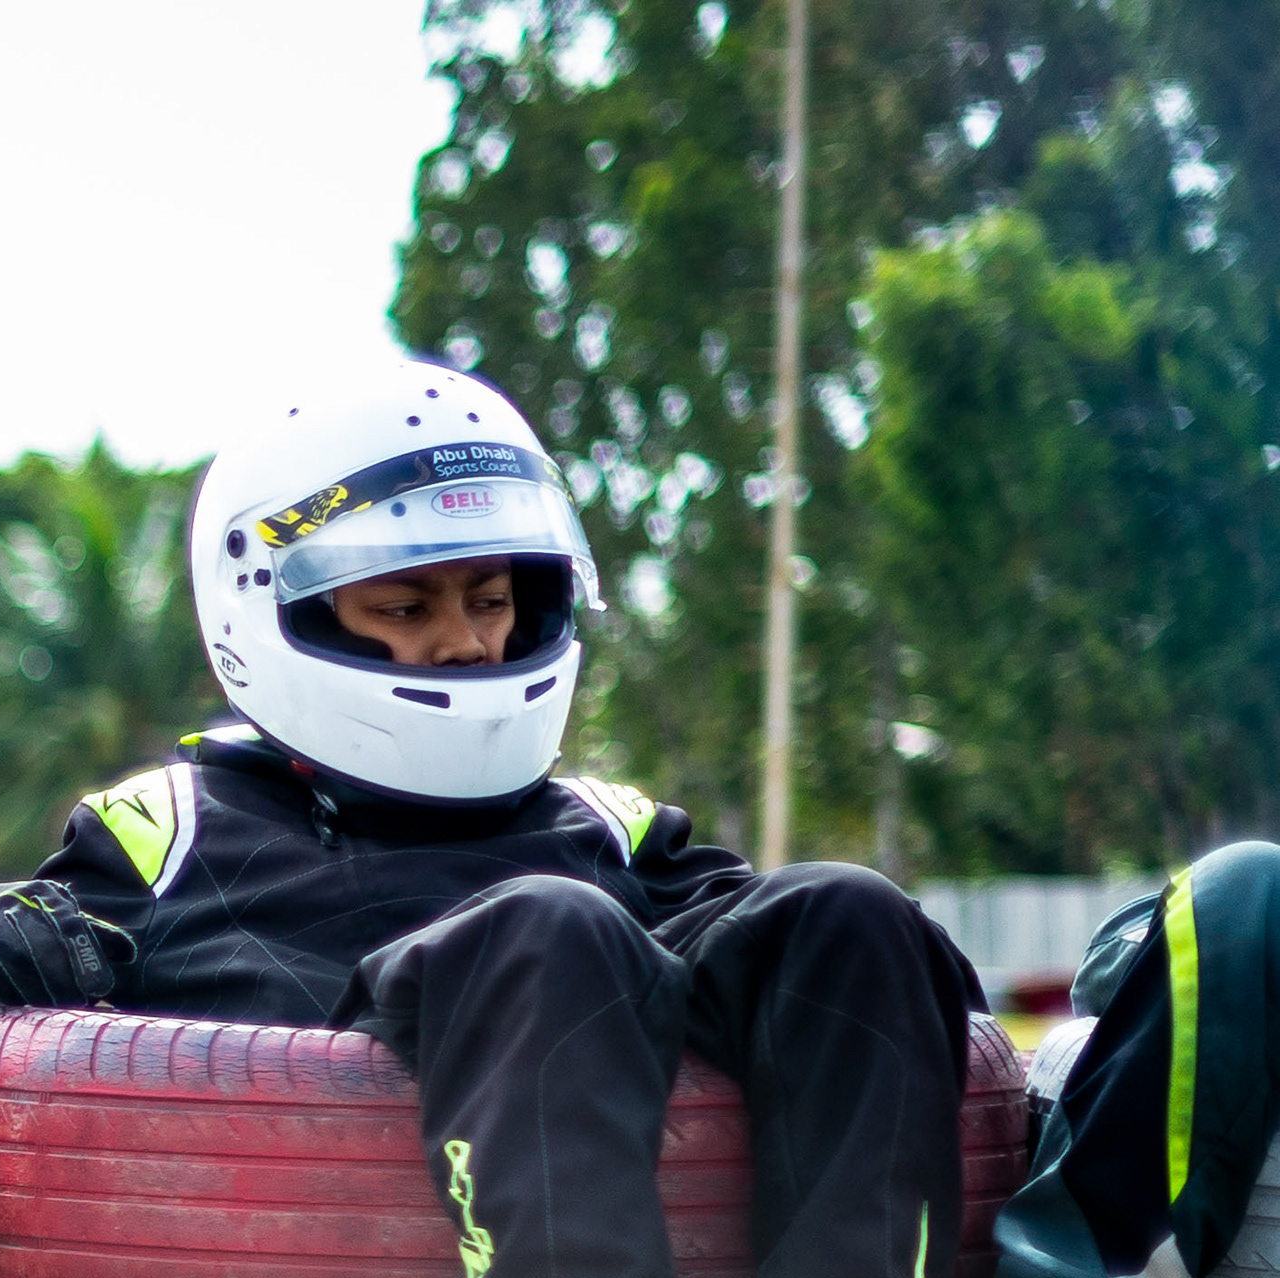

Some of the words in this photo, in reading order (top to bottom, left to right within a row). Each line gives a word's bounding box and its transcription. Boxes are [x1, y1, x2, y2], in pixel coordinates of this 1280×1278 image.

[433, 449, 467, 464] Abu
[470, 446, 516, 461] Dhabi
[435, 462, 479, 477] Sports
[480, 460, 521, 474] Council
[441, 491, 494, 509] BELL
[76, 934, 99, 972] OMP
